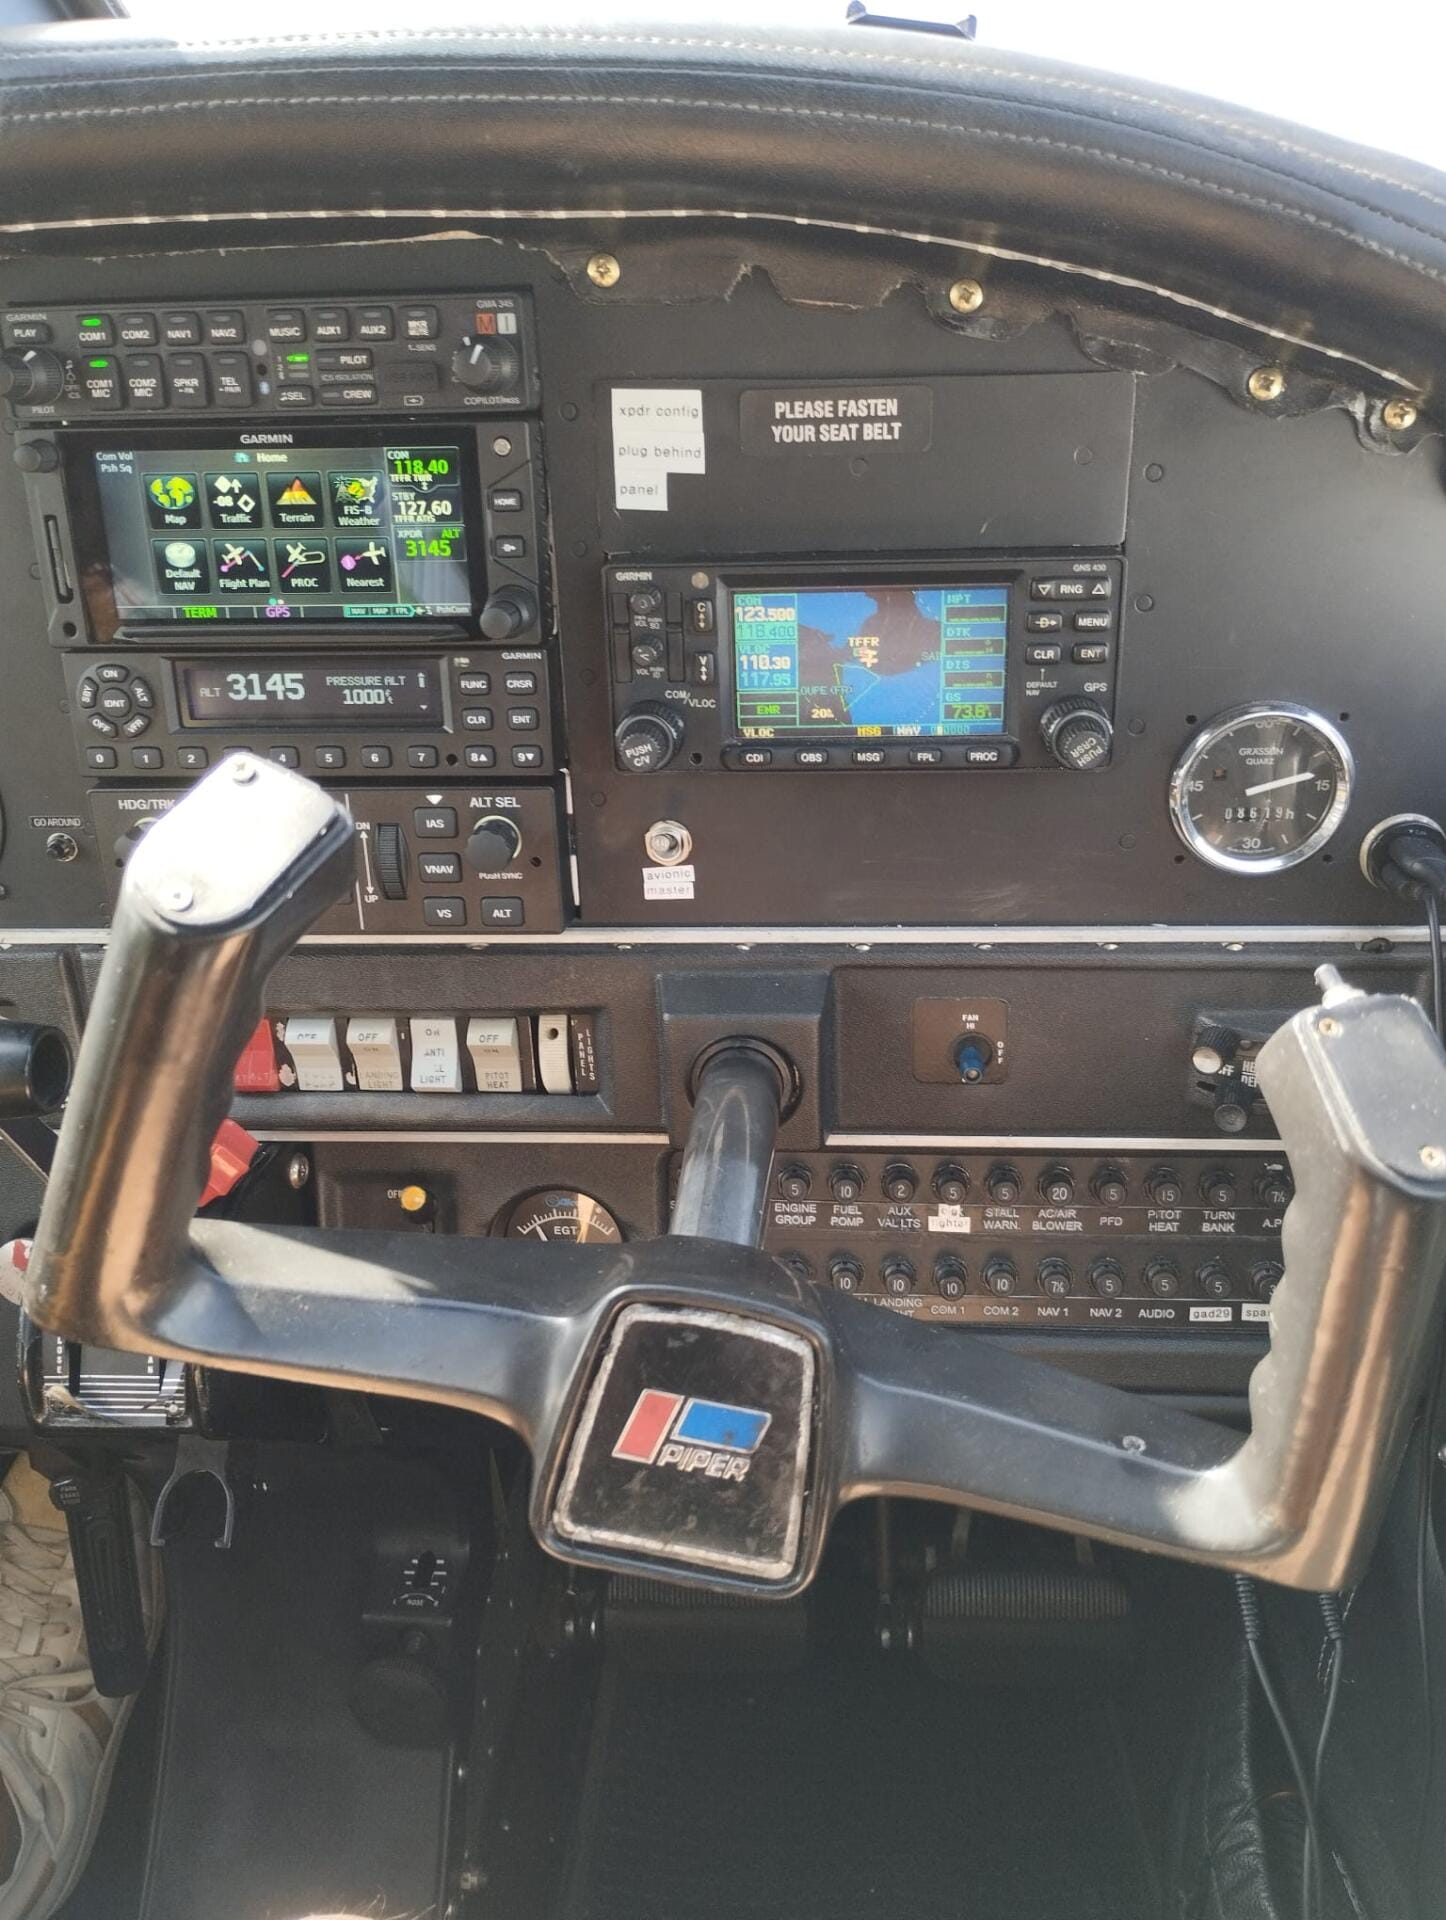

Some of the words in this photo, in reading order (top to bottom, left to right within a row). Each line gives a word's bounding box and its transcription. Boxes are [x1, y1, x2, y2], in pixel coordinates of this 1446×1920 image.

[6, 313, 47, 322] GARMIN
[14, 328, 36, 338] PLAY
[122, 329, 150, 340] COM2
[167, 329, 192, 339] NAV1
[211, 328, 237, 338] NAV2
[269, 327, 300, 337] MUSIC
[316, 326, 341, 335] AUX1
[360, 325, 386, 335] AUX2
[79, 331, 107, 342] COM1
[339, 355, 368, 365] PILOT
[86, 379, 113, 389] COM1
[129, 378, 157, 388] COM2
[173, 378, 199, 388] SPKR
[220, 376, 239, 386] TEL
[91, 389, 111, 398] MIC
[134, 388, 153, 398] MIC
[343, 390, 372, 399] CREW
[619, 405, 651, 418] xpdr
[656, 405, 699, 418] config
[775, 401, 834, 419] PLEASE
[838, 399, 898, 417] FASTEN
[771, 425, 815, 443] YOUR
[820, 424, 859, 441] SEAT
[863, 422, 902, 441] BELT
[240, 434, 293, 444] GARMIN
[96, 452, 117, 461] Com
[118, 452, 133, 461] Vol
[387, 451, 409, 460] COM
[619, 445, 648, 459] plug
[654, 446, 702, 459] behind
[256, 453, 288, 463] Home
[101, 464, 118, 473] Psh
[119, 464, 132, 474] Sq
[394, 459, 449, 475] 118.40
[620, 484, 659, 497] panel
[391, 492, 416, 500] STBY
[399, 500, 452, 515] 127.60
[494, 499, 517, 507] HOME
[165, 514, 187, 525] Map
[220, 513, 252, 524] Traffic
[279, 513, 315, 523] Terrain
[338, 516, 381, 526] Weather
[398, 530, 423, 538] XPDR
[441, 529, 460, 538] ALT
[406, 540, 452, 557] 3145
[165, 569, 202, 578] Default
[616, 572, 652, 581] GARMIN
[174, 582, 195, 590] NAV
[219, 578, 247, 589] Flight
[249, 578, 270, 588] Plan
[291, 578, 319, 587] PROC
[346, 578, 385, 587] Nearest
[1060, 584, 1083, 594] RNG
[183, 607, 218, 618] TERM
[266, 607, 291, 618] GPS
[735, 607, 796, 621] 123.500
[1078, 617, 1108, 627] MENU
[946, 628, 971, 637] DTK
[848, 637, 880, 647] TFFR
[501, 652, 542, 660] GARMIN
[1034, 650, 1055, 659] CLR
[1080, 649, 1101, 659] ENT
[740, 656, 791, 670] 110.30
[945, 660, 970, 669] DIS
[103, 670, 118, 678] ON
[326, 676, 382, 686] PRESSURE
[384, 676, 406, 686] ALT
[461, 680, 487, 689] FUNC
[506, 680, 533, 688] CRSR
[740, 673, 791, 686] 117.95
[200, 688, 222, 697] ALT
[226, 673, 305, 700] 3145
[1026, 681, 1058, 689] DEFAULT
[1083, 682, 1108, 692] GPS
[135, 687, 148, 703] ALT
[757, 704, 780, 714] ENR
[467, 716, 486, 724] CLR
[512, 715, 531, 724] ENT
[92, 718, 111, 733] OFF
[127, 718, 144, 733] VFR
[857, 726, 882, 736] MSG
[897, 726, 921, 736] NAV
[626, 744, 652, 757] PUSH
[746, 754, 764, 762] CDI
[801, 753, 822, 762] OBS
[857, 752, 880, 761] MSG
[917, 752, 935, 761] FPL
[970, 752, 998, 761] PROC
[1315, 779, 1330, 791] 15
[469, 797, 493, 808] ALT
[495, 797, 521, 808] SEL
[33, 818, 47, 827] GO
[48, 818, 81, 827] AROUND
[356, 822, 371, 830] DN
[426, 819, 444, 828] IAS
[1242, 838, 1261, 849] 30
[424, 865, 454, 874] VNAV
[647, 870, 691, 880] avionic
[647, 886, 690, 895] master
[364, 895, 378, 903] UP
[437, 909, 452, 918] VS
[493, 909, 512, 918] ALT
[962, 1014, 979, 1022] FAN
[358, 1033, 379, 1042] OFF
[479, 1034, 499, 1043] OFF
[485, 1072, 510, 1080] PITOT
[792, 1185, 799, 1196] 5
[841, 1186, 852, 1198] 10
[897, 1186, 905, 1197] 2
[950, 1188, 957, 1198] 5
[1001, 1188, 1009, 1198] 5
[1052, 1188, 1067, 1199] 20
[1109, 1189, 1117, 1200] 5
[1162, 1190, 1174, 1201] 15
[1219, 1191, 1226, 1201] 5
[775, 1204, 817, 1213] ENGINE
[833, 1205, 862, 1214] FUEL
[888, 1207, 911, 1215] AUX
[985, 1208, 1019, 1217] STALL
[1038, 1209, 1077, 1218] AC/AIR
[1147, 1210, 1182, 1220] PITOT
[1204, 1211, 1235, 1220] TURN
[776, 1216, 816, 1225] GROUP
[983, 1220, 1021, 1230] WARN.
[1100, 1217, 1123, 1226] PFD
[554, 1226, 578, 1235] EGT
[1032, 1221, 1083, 1231] BLOWER
[1149, 1222, 1180, 1232] HEAT
[1202, 1223, 1235, 1232] BANK
[840, 1278, 851, 1289] 10
[893, 1279, 904, 1290] 10
[947, 1283, 958, 1294] 10
[997, 1279, 1008, 1289] 10
[1106, 1281, 1114, 1291] 5
[1161, 1280, 1169, 1291] 5
[1215, 1282, 1222, 1293] 5
[874, 1298, 923, 1307] LANDING
[931, 1306, 955, 1315] COM
[959, 1306, 965, 1314] 1
[983, 1307, 1009, 1315] COM
[1011, 1307, 1019, 1315] 2
[1037, 1308, 1061, 1316] NAV
[1090, 1309, 1113, 1317] NAV
[1115, 1308, 1122, 1317] 2
[1138, 1309, 1174, 1318] AUDIO
[1193, 1309, 1230, 1319] gad29
[657, 1444, 750, 1482] PIPER
